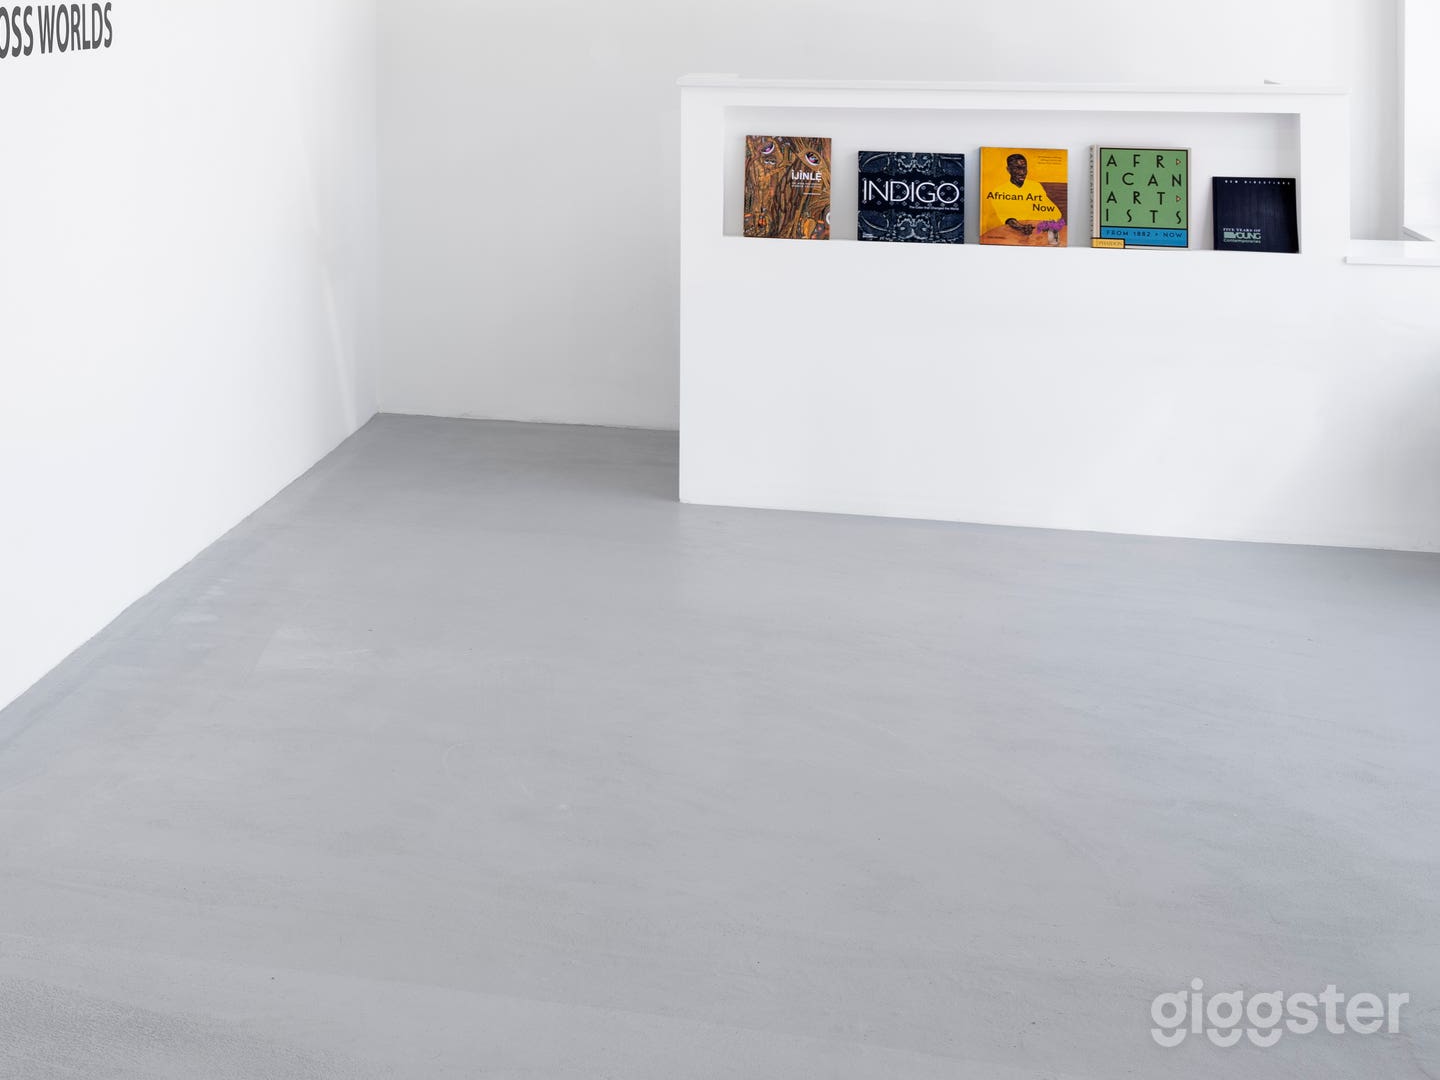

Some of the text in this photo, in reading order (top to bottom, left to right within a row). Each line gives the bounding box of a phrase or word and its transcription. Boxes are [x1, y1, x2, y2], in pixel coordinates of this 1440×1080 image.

[37, 1, 113, 55] WORLDS
[863, 180, 960, 204] INDIGO
[986, 191, 1043, 202] African Art
[1032, 203, 1055, 212] Now
